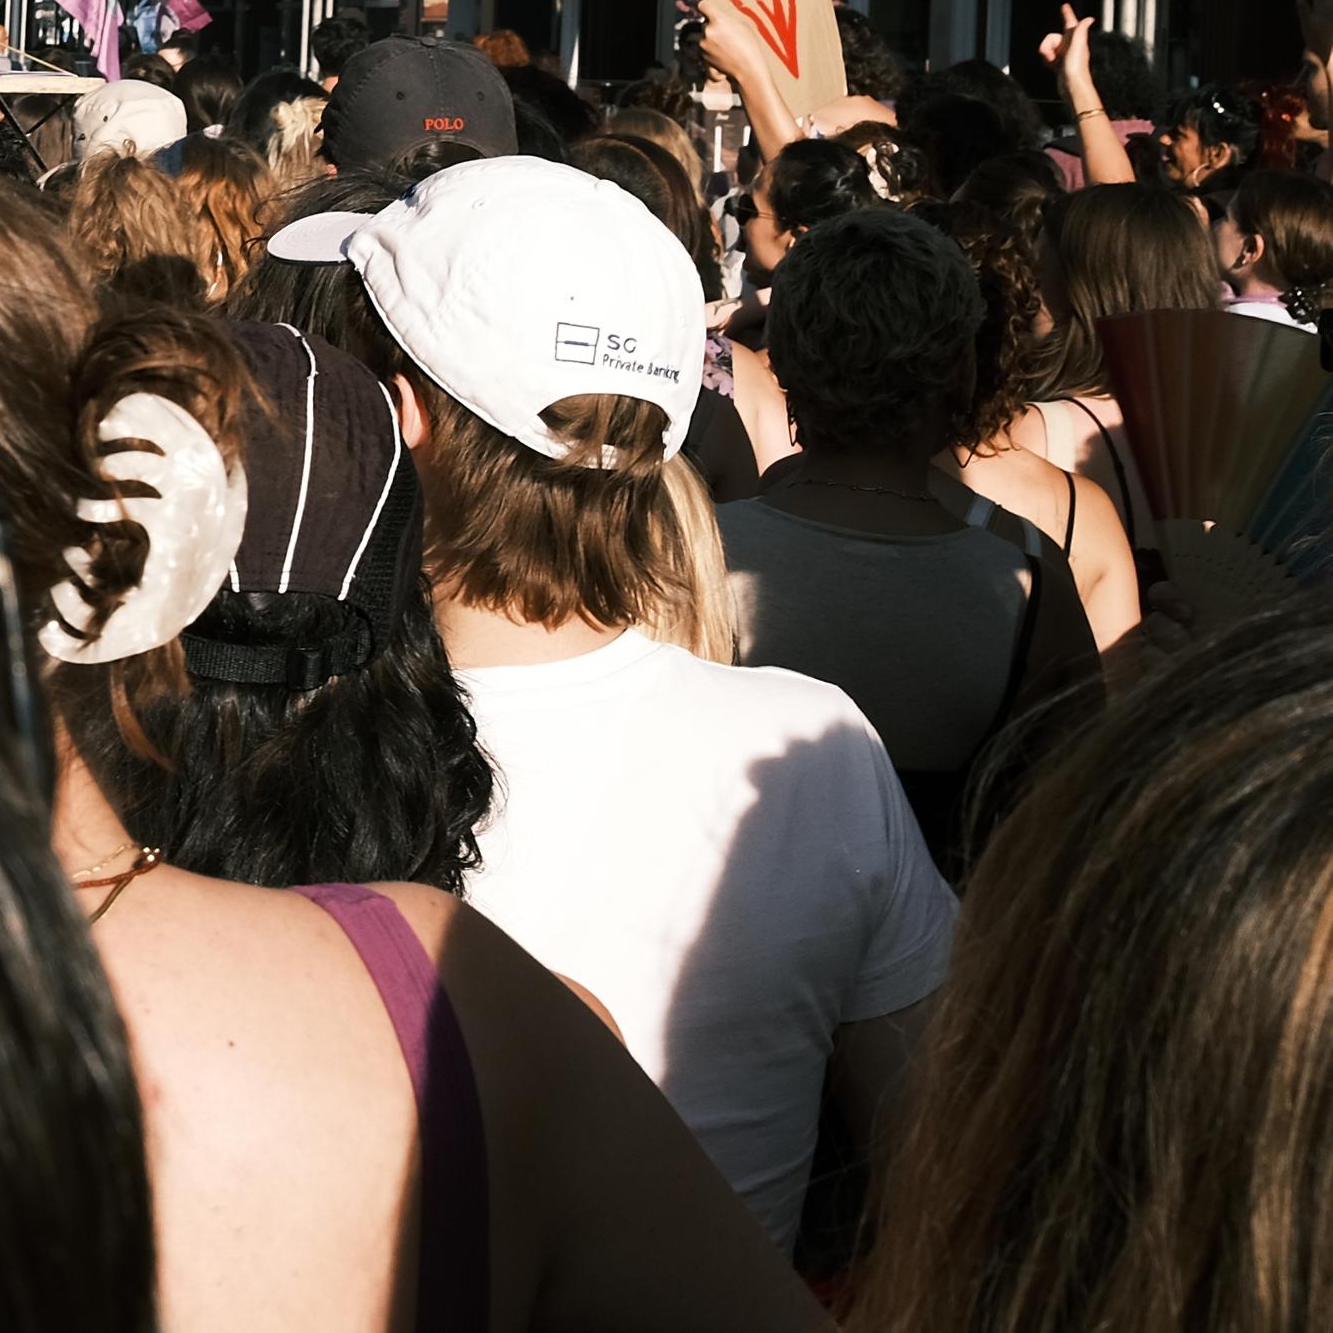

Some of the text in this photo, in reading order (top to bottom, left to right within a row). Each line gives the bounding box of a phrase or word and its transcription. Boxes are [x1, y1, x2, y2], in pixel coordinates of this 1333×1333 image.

[424, 117, 465, 131] POLO
[607, 334, 637, 354] SG
[603, 353, 680, 384] Private Banking
